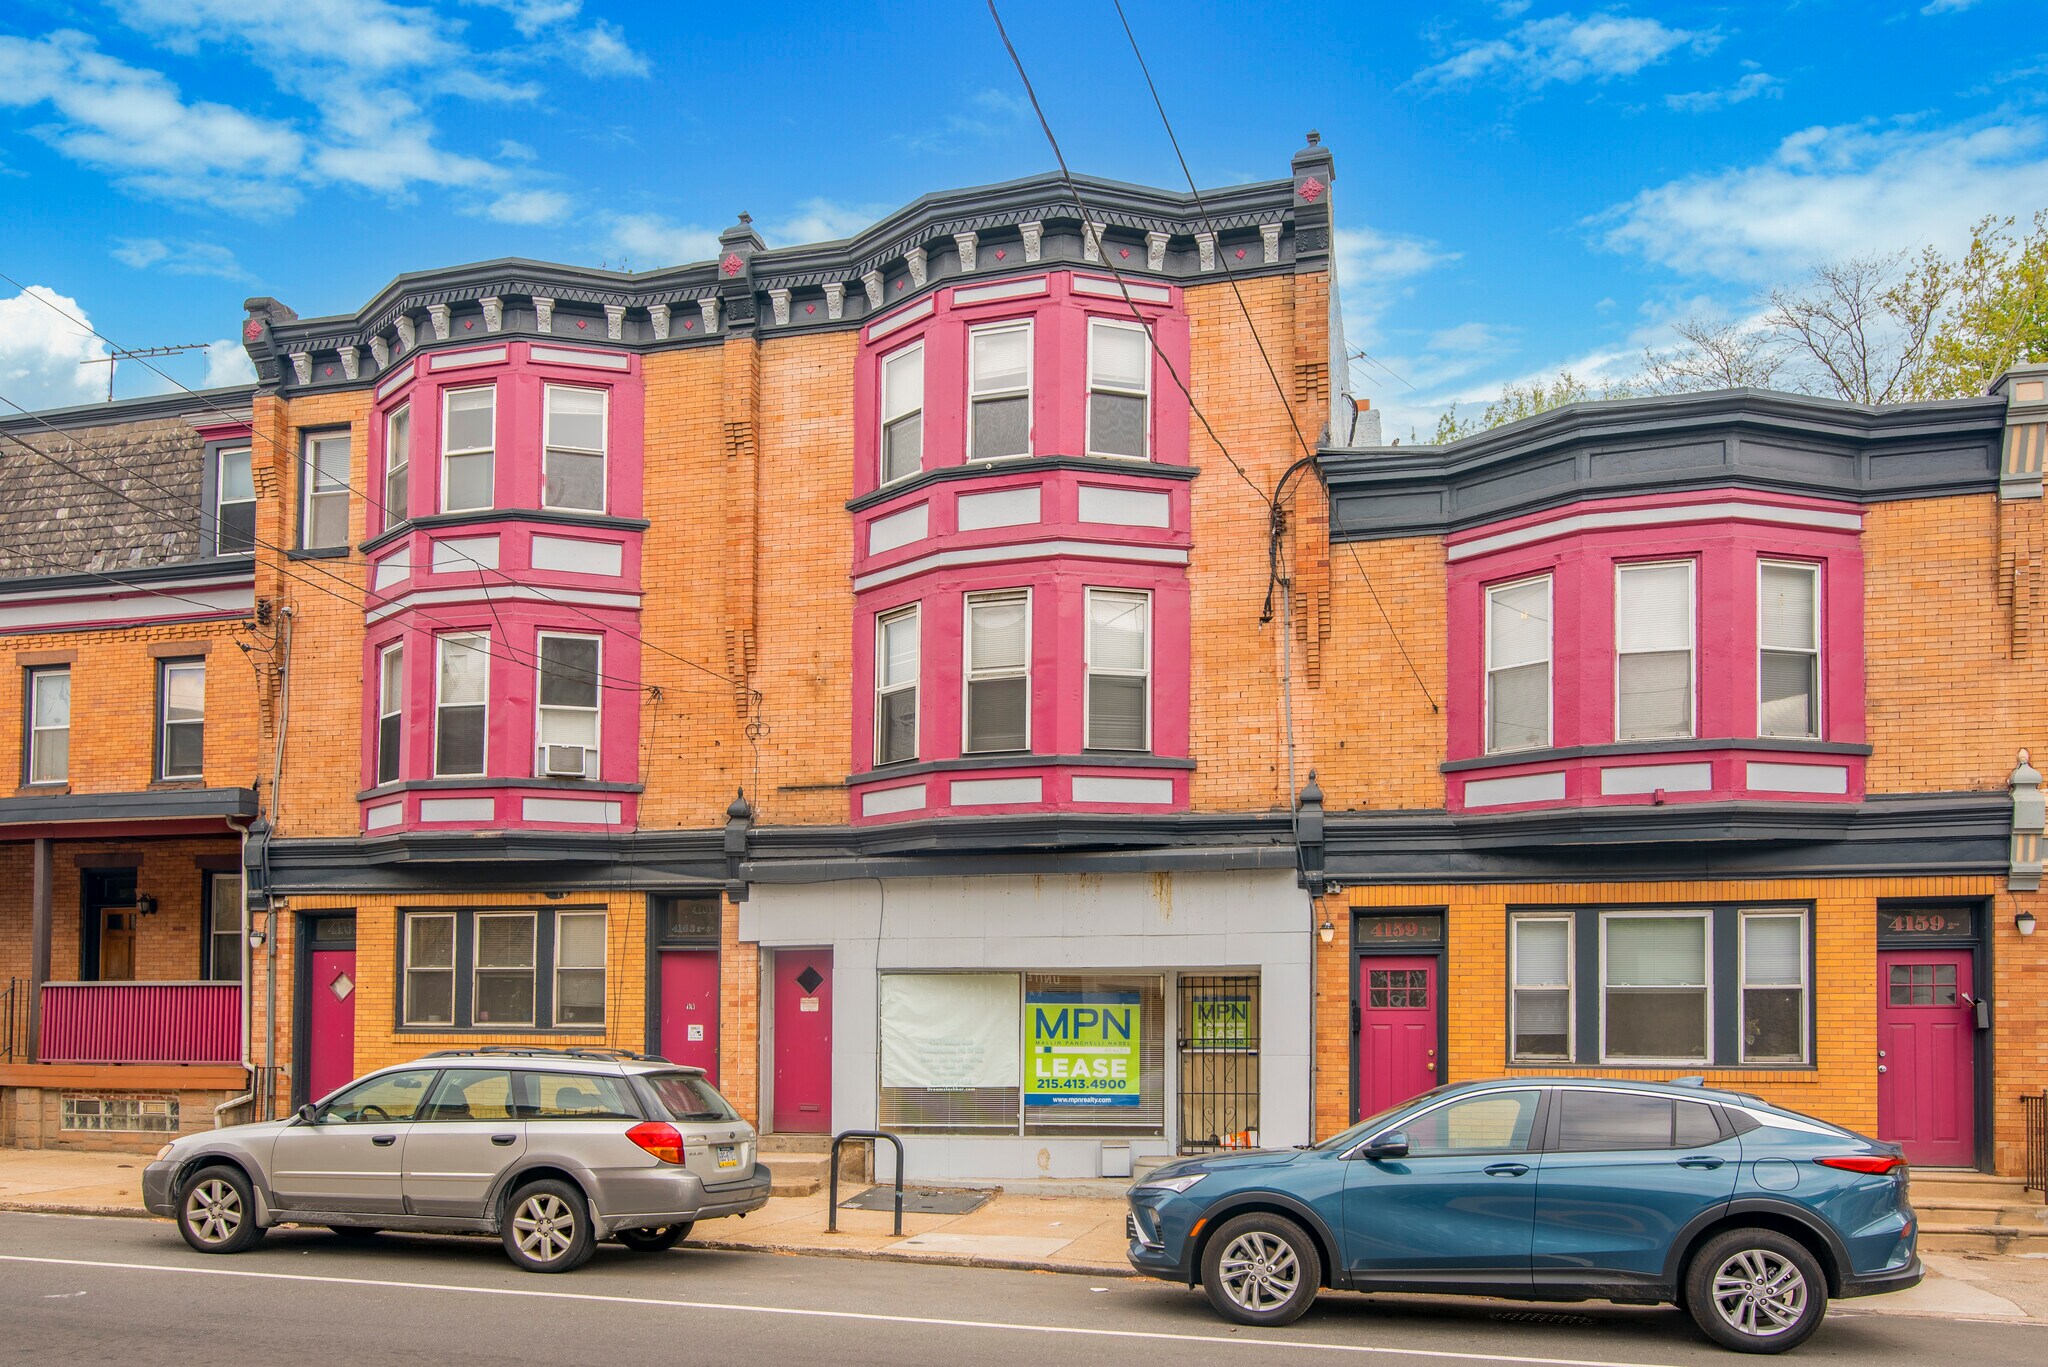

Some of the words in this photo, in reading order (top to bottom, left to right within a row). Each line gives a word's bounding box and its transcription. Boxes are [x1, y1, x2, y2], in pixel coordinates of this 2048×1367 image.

[1370, 921, 1418, 937] 4159
[1888, 915, 1945, 931] 4159
[1198, 1004, 1246, 1020] MPN
[1035, 1008, 1131, 1039] MPN
[1198, 1029, 1245, 1038] LEASE
[1036, 1058, 1127, 1078] LEASE
[1037, 1079, 1127, 1089] 215.413.4900
